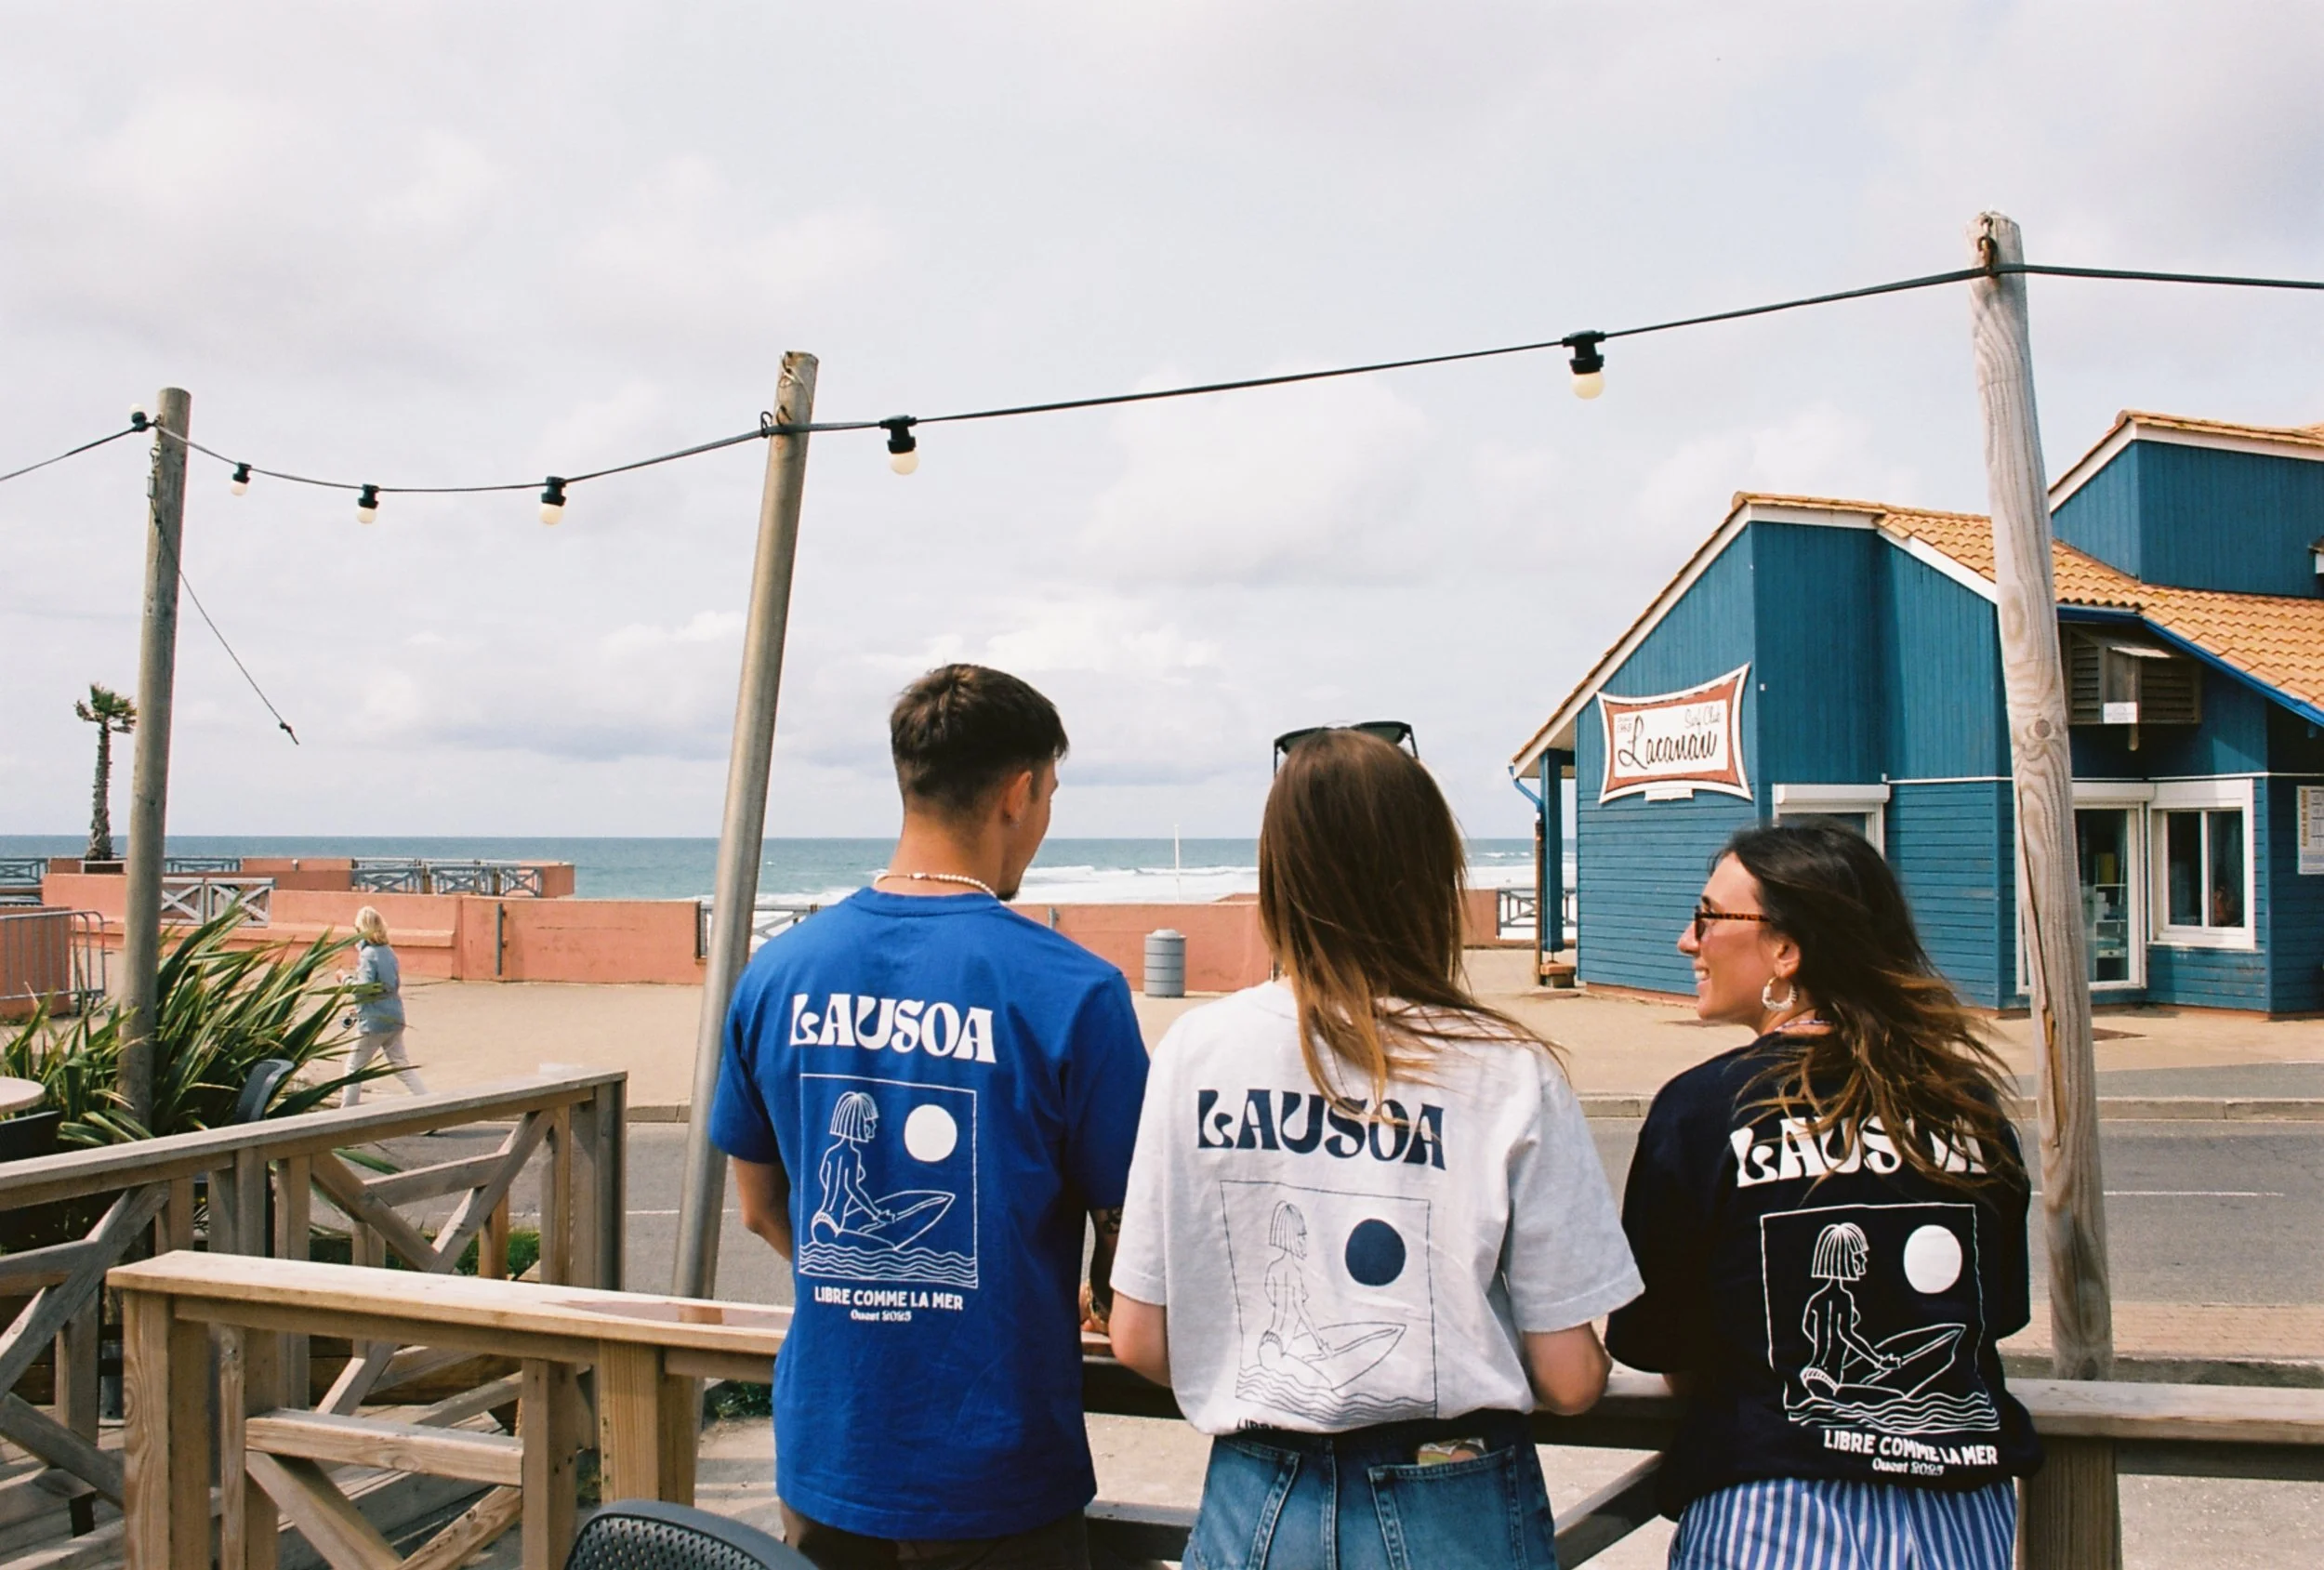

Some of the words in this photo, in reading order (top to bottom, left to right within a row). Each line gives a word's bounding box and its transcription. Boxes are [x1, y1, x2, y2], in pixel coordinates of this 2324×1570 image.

[1618, 715, 1717, 770] Lacanau
[790, 994, 997, 1063] LAUSOA
[1197, 1088, 1446, 1170] LAUSOA
[814, 1286, 851, 1305] LIBRE
[853, 1290, 907, 1307] COMME
[910, 1291, 929, 1308] LA
[931, 1292, 964, 1311] MER
[1823, 1429, 1876, 1455] LIBRE
[1879, 1436, 1940, 1462] COMME
[1940, 1446, 1961, 1465] LA
[1961, 1445, 1998, 1466] MER
[1871, 1457, 1908, 1474] Ouest
